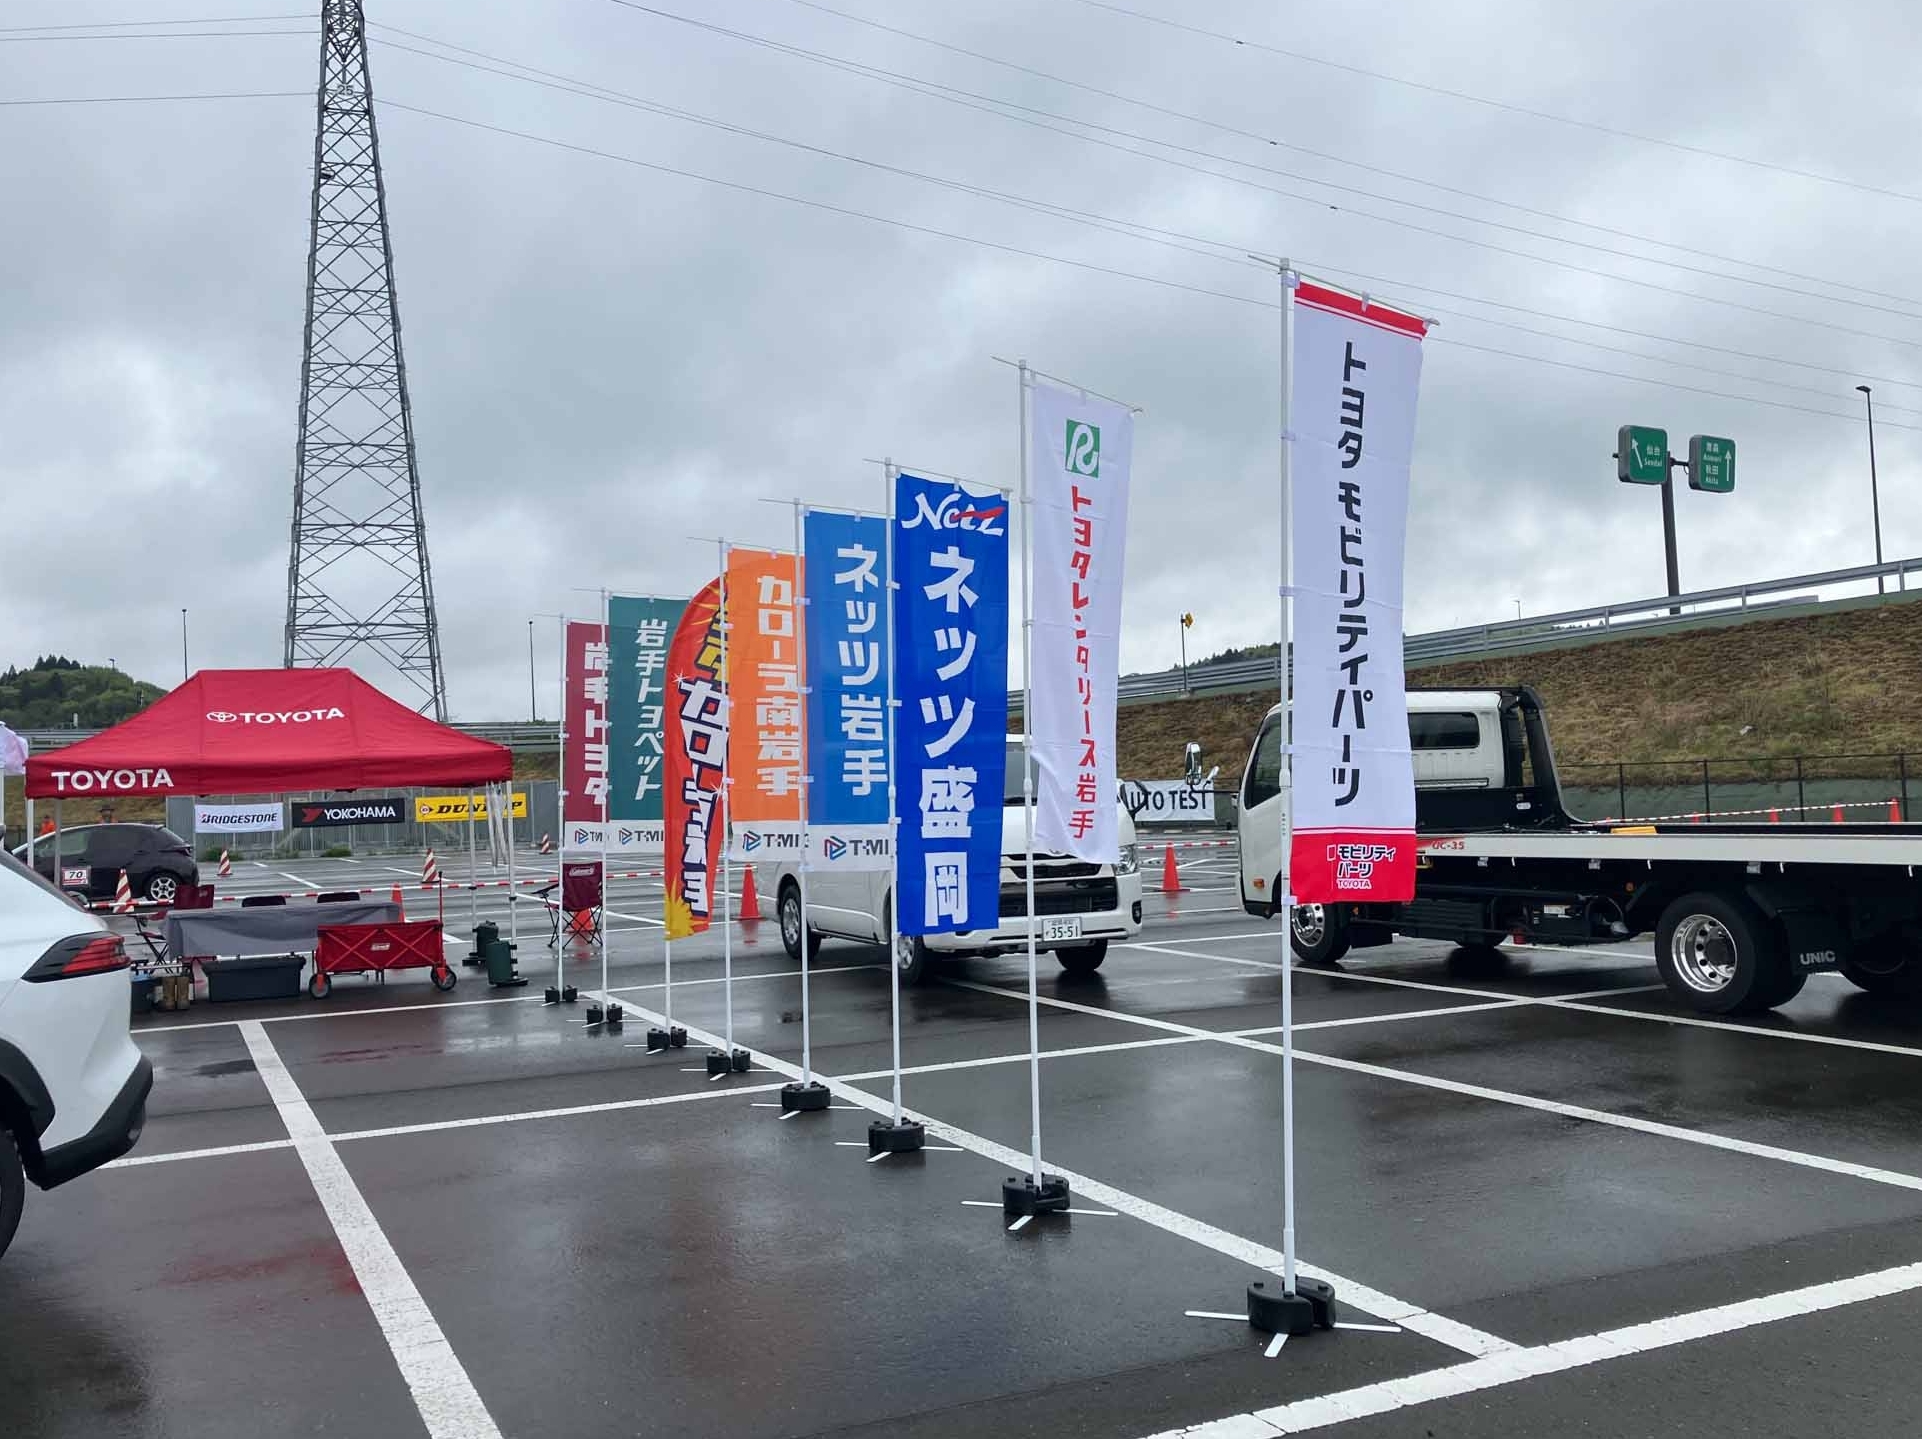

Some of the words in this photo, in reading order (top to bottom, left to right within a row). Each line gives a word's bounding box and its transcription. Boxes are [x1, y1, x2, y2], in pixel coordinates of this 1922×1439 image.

[1338, 341, 1367, 469] トヨタ
[834, 543, 888, 797] ネッツ岩手
[1069, 485, 1098, 839] トヨタレンタリース岩手
[239, 707, 345, 724] TOYOTA
[634, 618, 668, 801] 岩手トヨペット
[919, 545, 979, 928] ネッツ盛岡
[51, 768, 174, 791] TOYOTA
[437, 801, 523, 814] DUNP
[1168, 790, 1213, 810] TEST
[201, 811, 278, 825] BRIDGESTONE
[324, 805, 396, 820] YOKOHAMA
[1337, 845, 1396, 861] モビリティ
[69, 871, 83, 879] 70
[1337, 879, 1371, 889] TOYOTA
[1051, 926, 1079, 939] 35-51
[1800, 950, 1836, 965] UNIC
